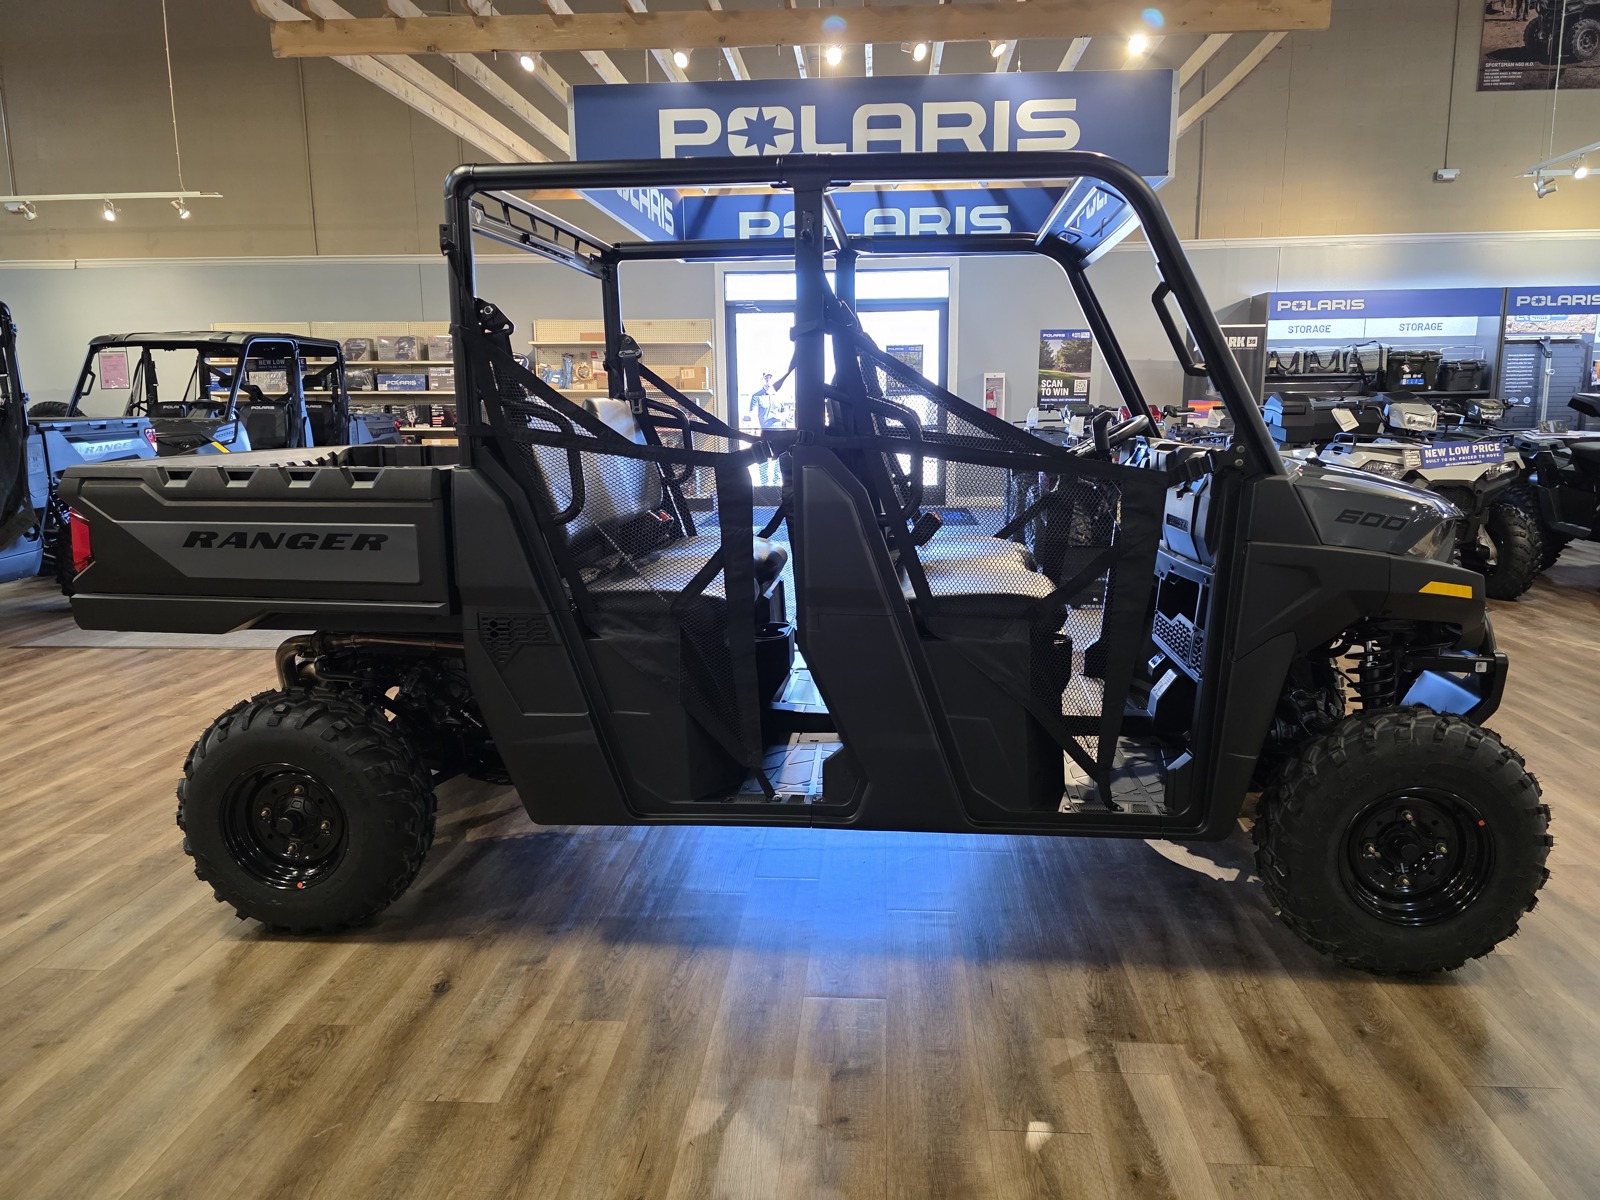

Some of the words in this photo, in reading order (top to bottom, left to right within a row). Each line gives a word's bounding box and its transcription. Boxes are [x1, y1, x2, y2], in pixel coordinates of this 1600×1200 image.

[659, 98, 1081, 158] POLARIS
[1276, 299, 1365, 312] POLARIS
[1516, 294, 1600, 307] POLARIS
[1288, 325, 1332, 334] STORAGE
[1399, 322, 1444, 332] STORAGE
[1041, 380, 1063, 388] SCAN
[1041, 388, 1052, 396] TO
[1053, 388, 1069, 396] WIN
[1425, 448, 1446, 458] NEW
[1449, 446, 1469, 455] LOW
[1472, 443, 1500, 453] PRICE
[1334, 508, 1411, 531] 600
[182, 530, 389, 551] RANGER
